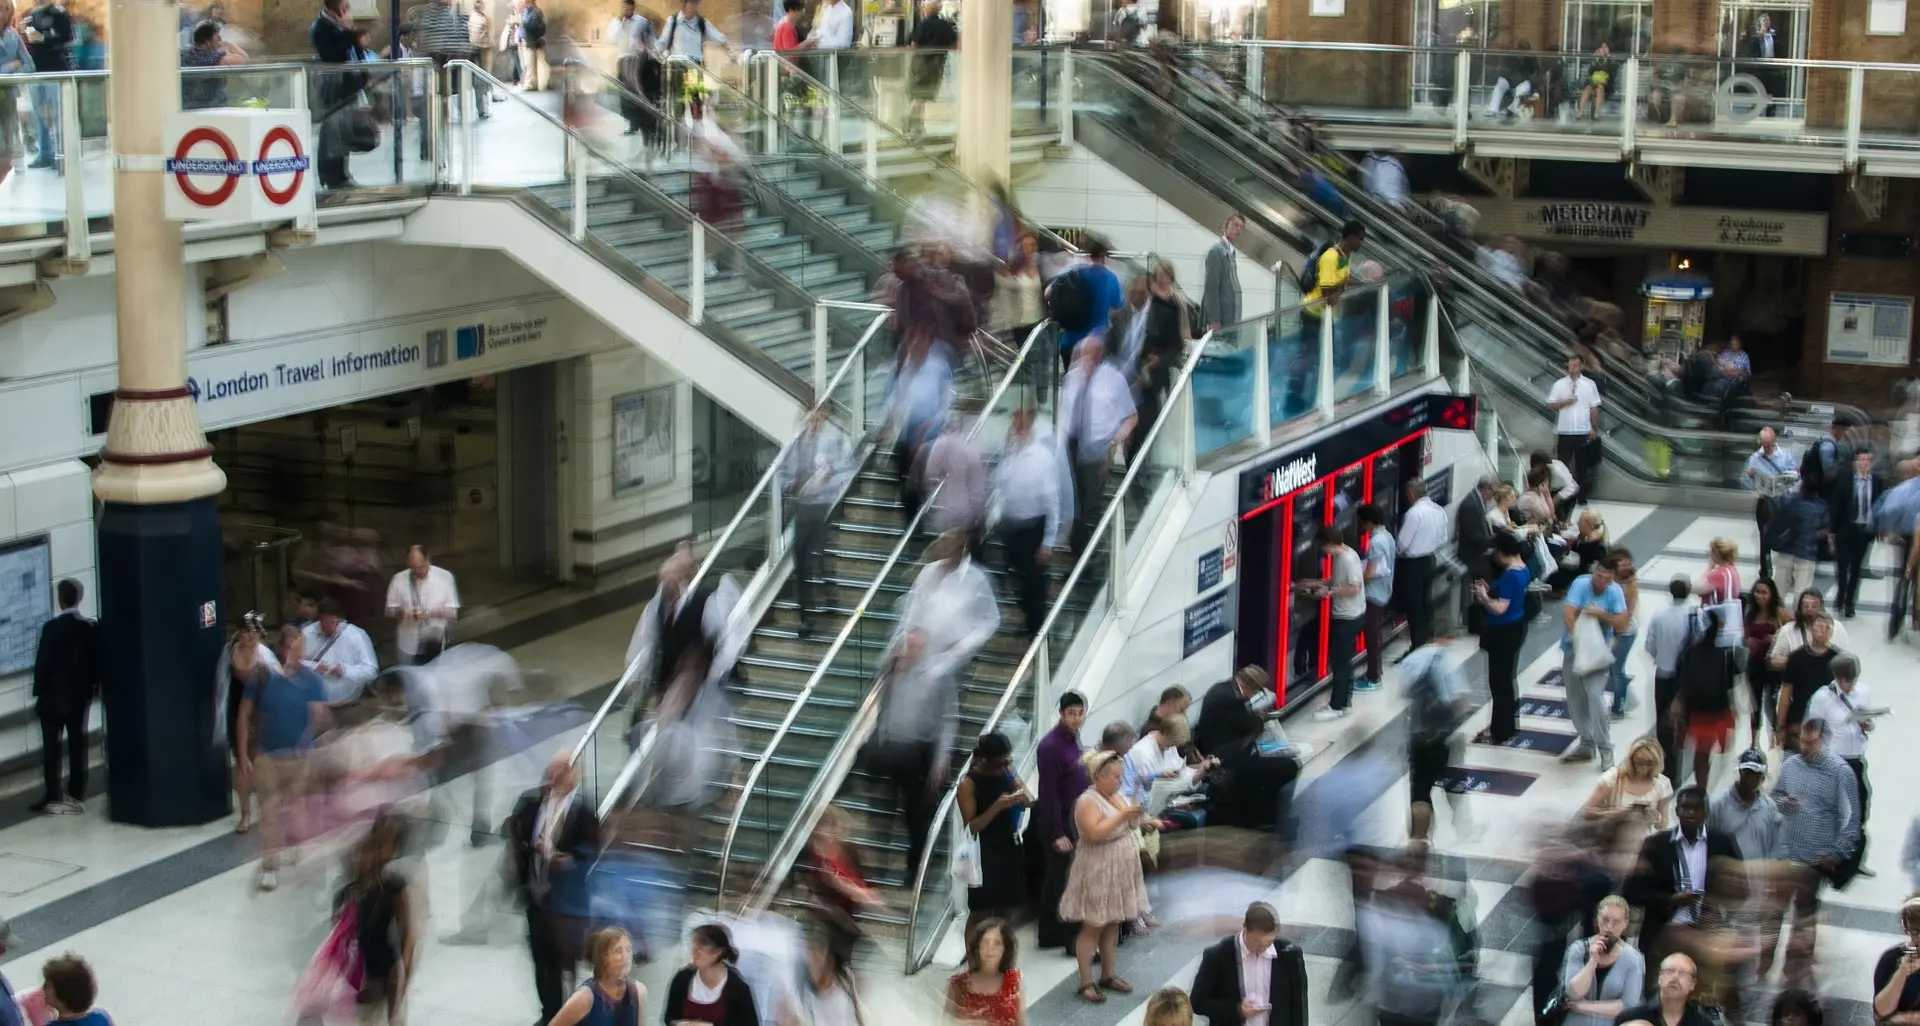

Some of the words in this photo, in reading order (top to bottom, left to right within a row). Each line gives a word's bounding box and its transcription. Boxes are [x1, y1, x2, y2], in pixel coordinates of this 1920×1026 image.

[171, 159, 243, 172] UNDERGROUND
[255, 158, 307, 172] UNDERGROUND
[1541, 202, 1650, 227] MERCHANT
[1717, 215, 1786, 230] Freehouse
[1555, 223, 1635, 239] BISHOPSGATE
[1733, 229, 1783, 244] Kitchen
[206, 371, 269, 401] London
[276, 357, 325, 386] Travel
[332, 343, 420, 377] Information
[1275, 452, 1317, 498] NatWest
